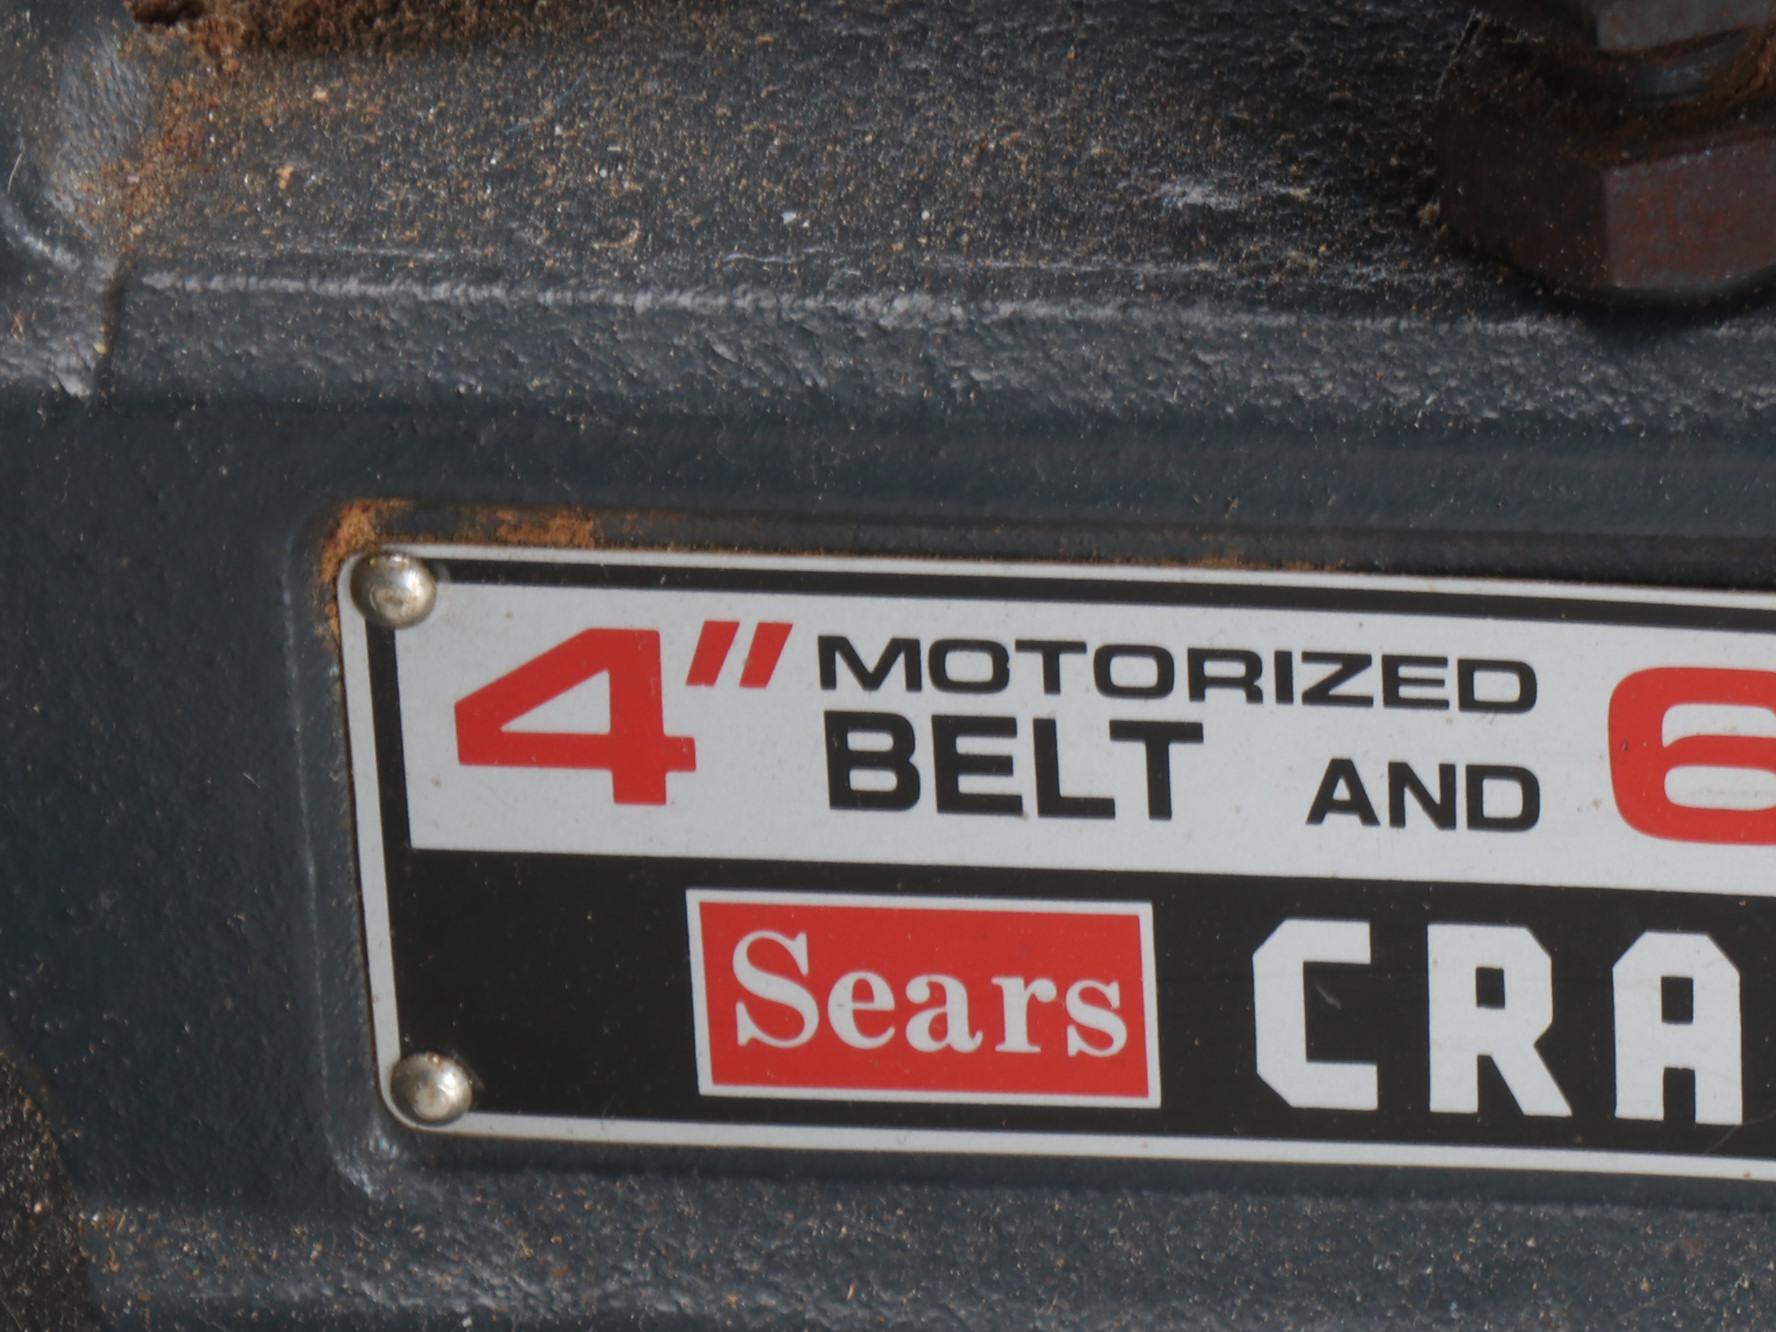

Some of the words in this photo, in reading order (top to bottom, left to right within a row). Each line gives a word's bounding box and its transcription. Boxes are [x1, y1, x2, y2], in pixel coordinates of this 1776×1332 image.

[817, 635, 1538, 716] MOTORIZED
[823, 710, 1204, 820] BELT
[1307, 758, 1541, 832] AND
[732, 930, 1128, 1057] Sears
